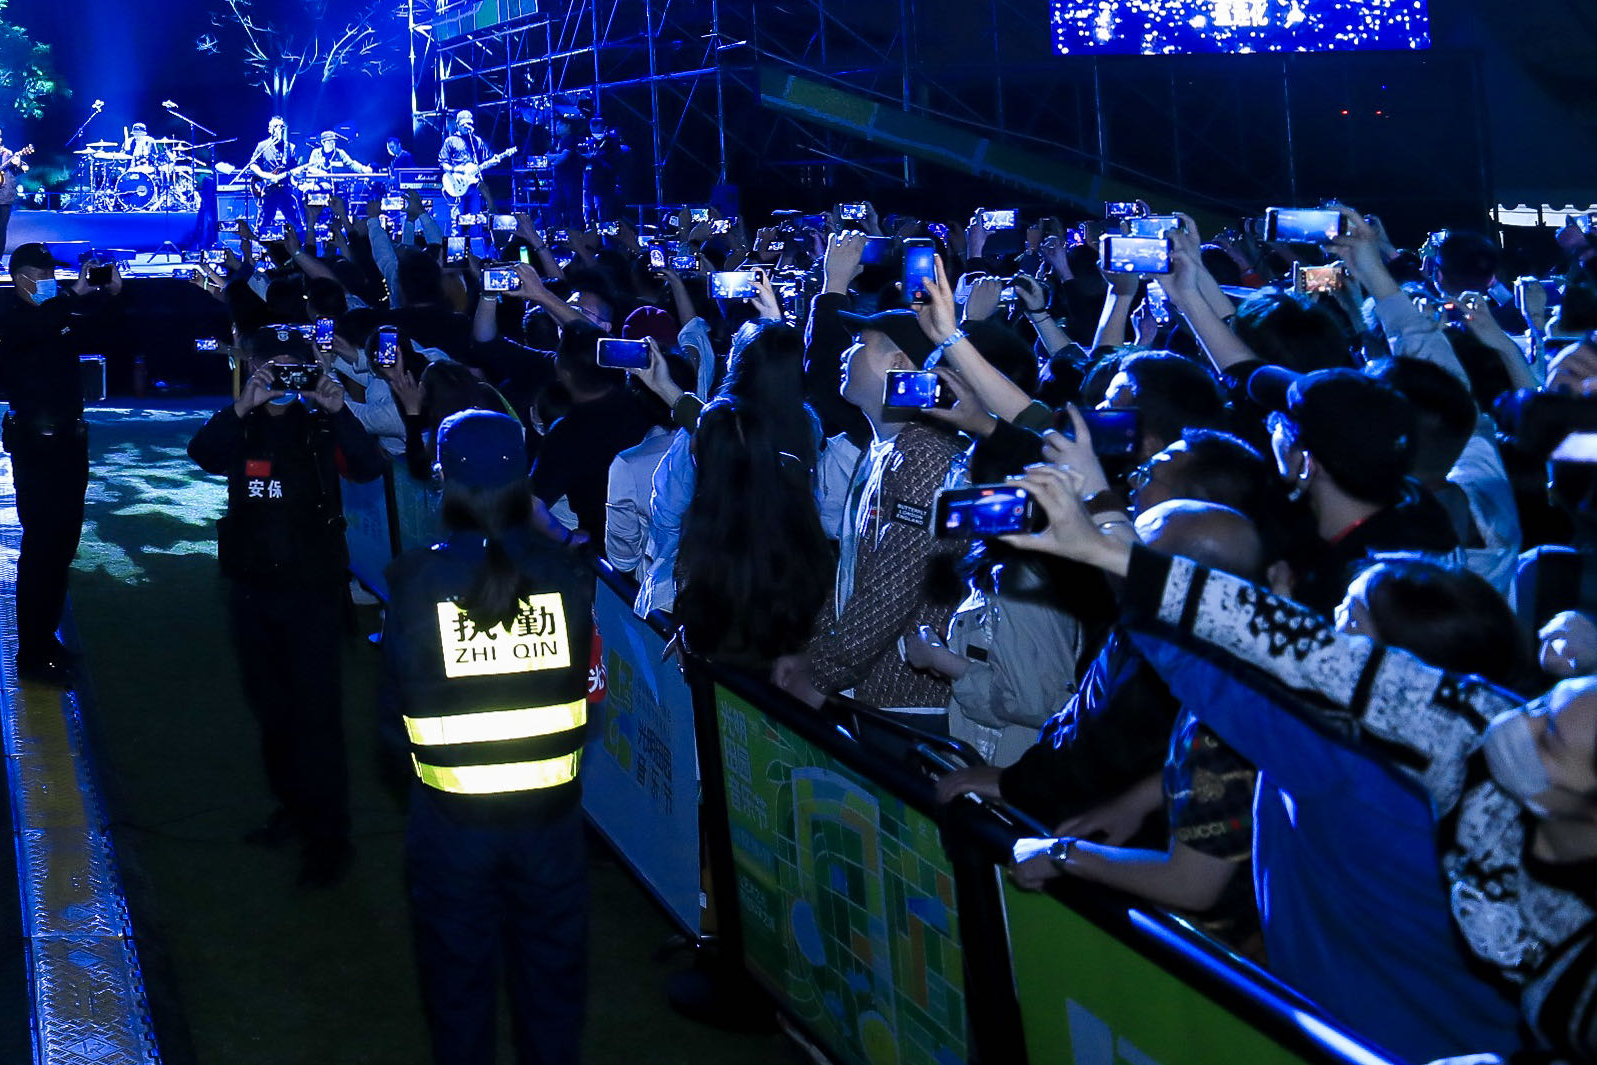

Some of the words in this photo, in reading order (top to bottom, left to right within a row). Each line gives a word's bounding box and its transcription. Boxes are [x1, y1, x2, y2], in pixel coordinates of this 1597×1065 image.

[248, 479, 283, 498] 安保
[454, 646, 497, 664] ZHI
[513, 640, 558, 660] QIN
